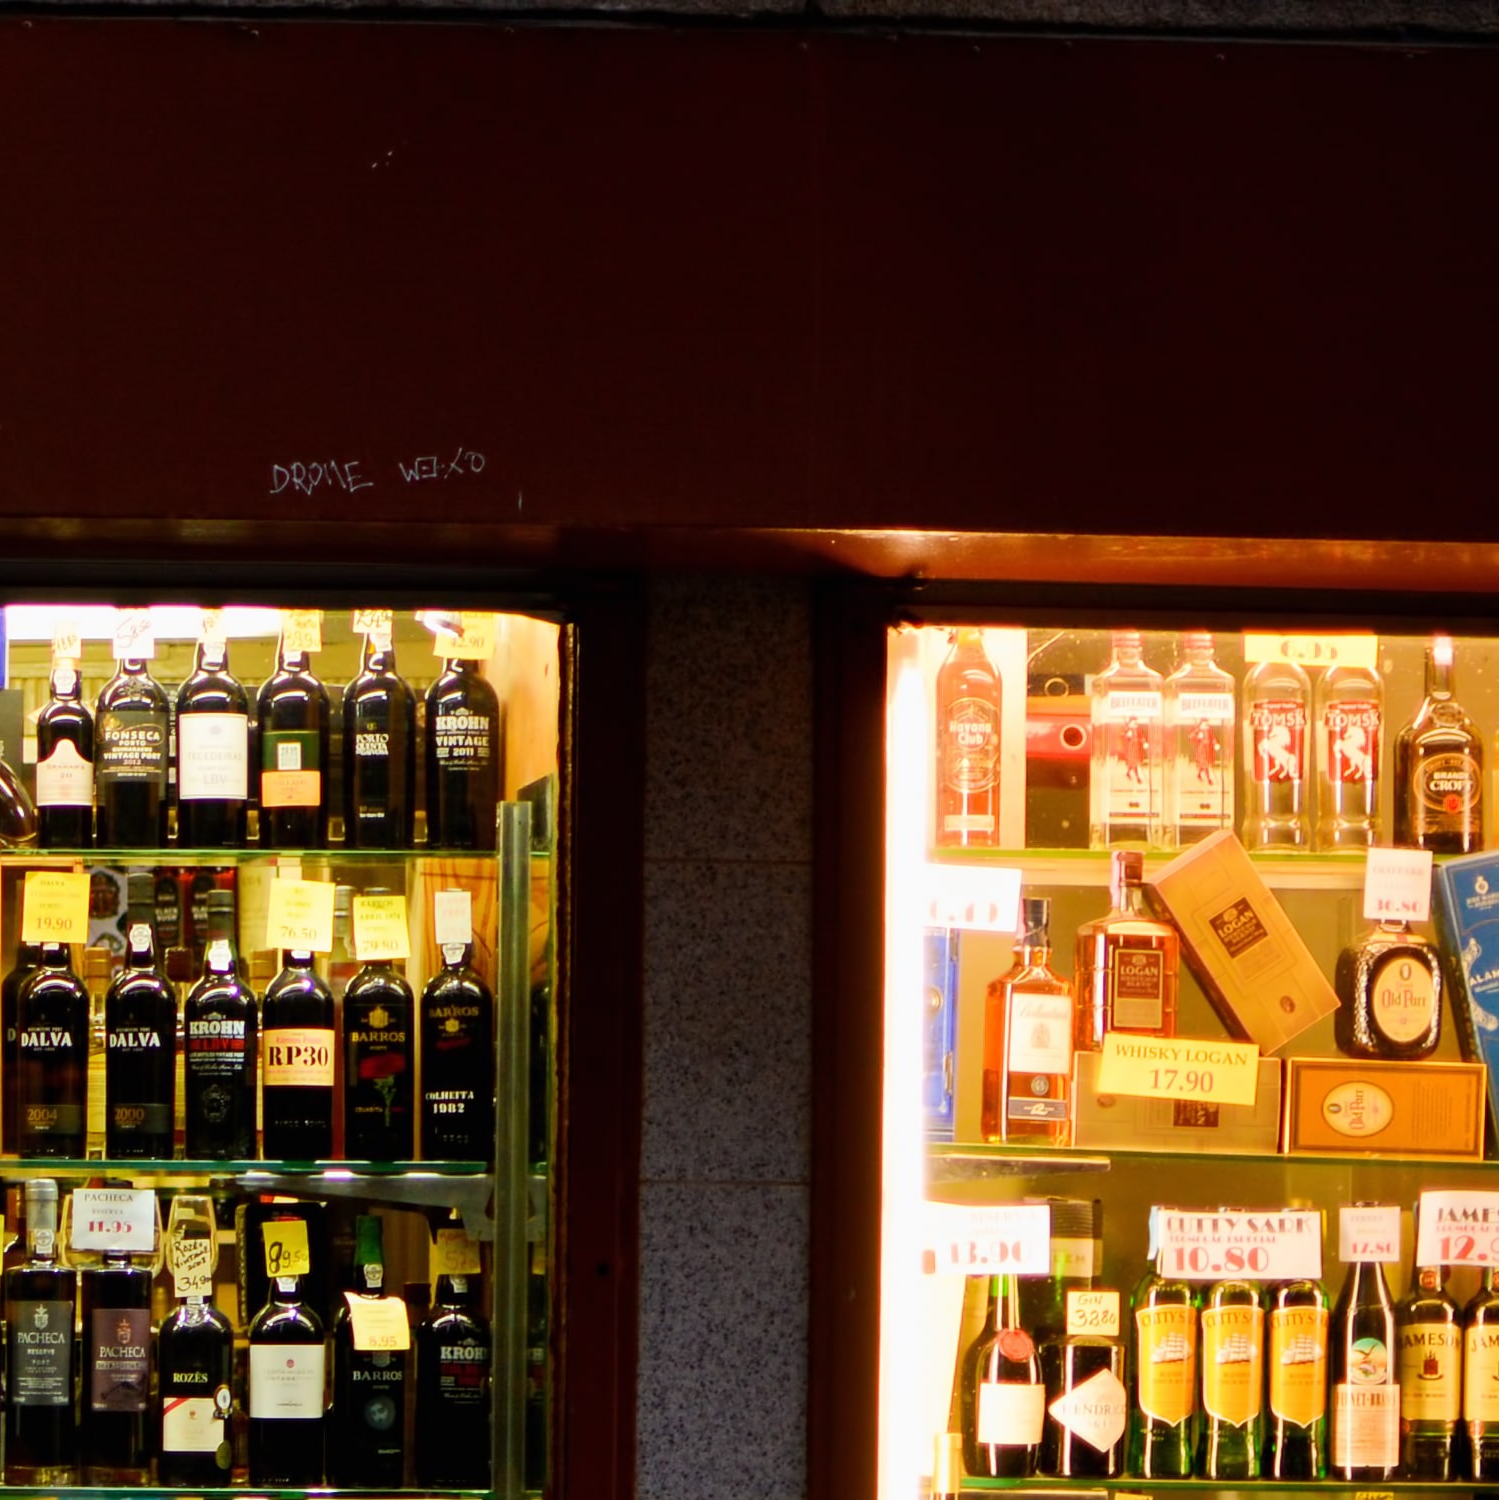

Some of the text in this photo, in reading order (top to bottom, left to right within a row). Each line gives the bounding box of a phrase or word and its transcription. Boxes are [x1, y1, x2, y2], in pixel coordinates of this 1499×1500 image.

[1109, 695, 1160, 711] BEEFEATER
[1180, 695, 1232, 712] BEEFEATER
[435, 716, 490, 731] KROHN
[1252, 710, 1307, 728] TOMSK
[1324, 710, 1380, 728] TOMSK
[949, 721, 993, 735] Havana
[105, 730, 161, 743] FONSECA
[435, 735, 490, 748] VINTAGE
[957, 732, 984, 745] Club
[1429, 779, 1474, 792] CROFT
[35, 916, 74, 932] 19.90
[1217, 911, 1257, 940] LOGAN
[1121, 966, 1160, 978] LOGAN
[428, 1005, 479, 1018] BARROS
[189, 1019, 246, 1036] KROHN
[21, 1031, 73, 1049] DALVA
[109, 1031, 161, 1049] DALVA
[351, 1031, 406, 1043] BARROS
[268, 1045, 329, 1067] RP30
[1115, 1044, 1248, 1067] WHISKY LOGAN
[1150, 1068, 1215, 1094] 17.90
[27, 1107, 58, 1121] 2004
[432, 1102, 465, 1115] 1982
[84, 1193, 134, 1203] PACHECA
[88, 1221, 132, 1234] 11.95
[1167, 1215, 1313, 1234] CUTTY SARK
[1173, 1246, 1271, 1272] 10.80
[17, 1332, 65, 1344] PACHECA
[99, 1346, 146, 1359] PACHECA
[353, 1370, 403, 1381] BARROS
